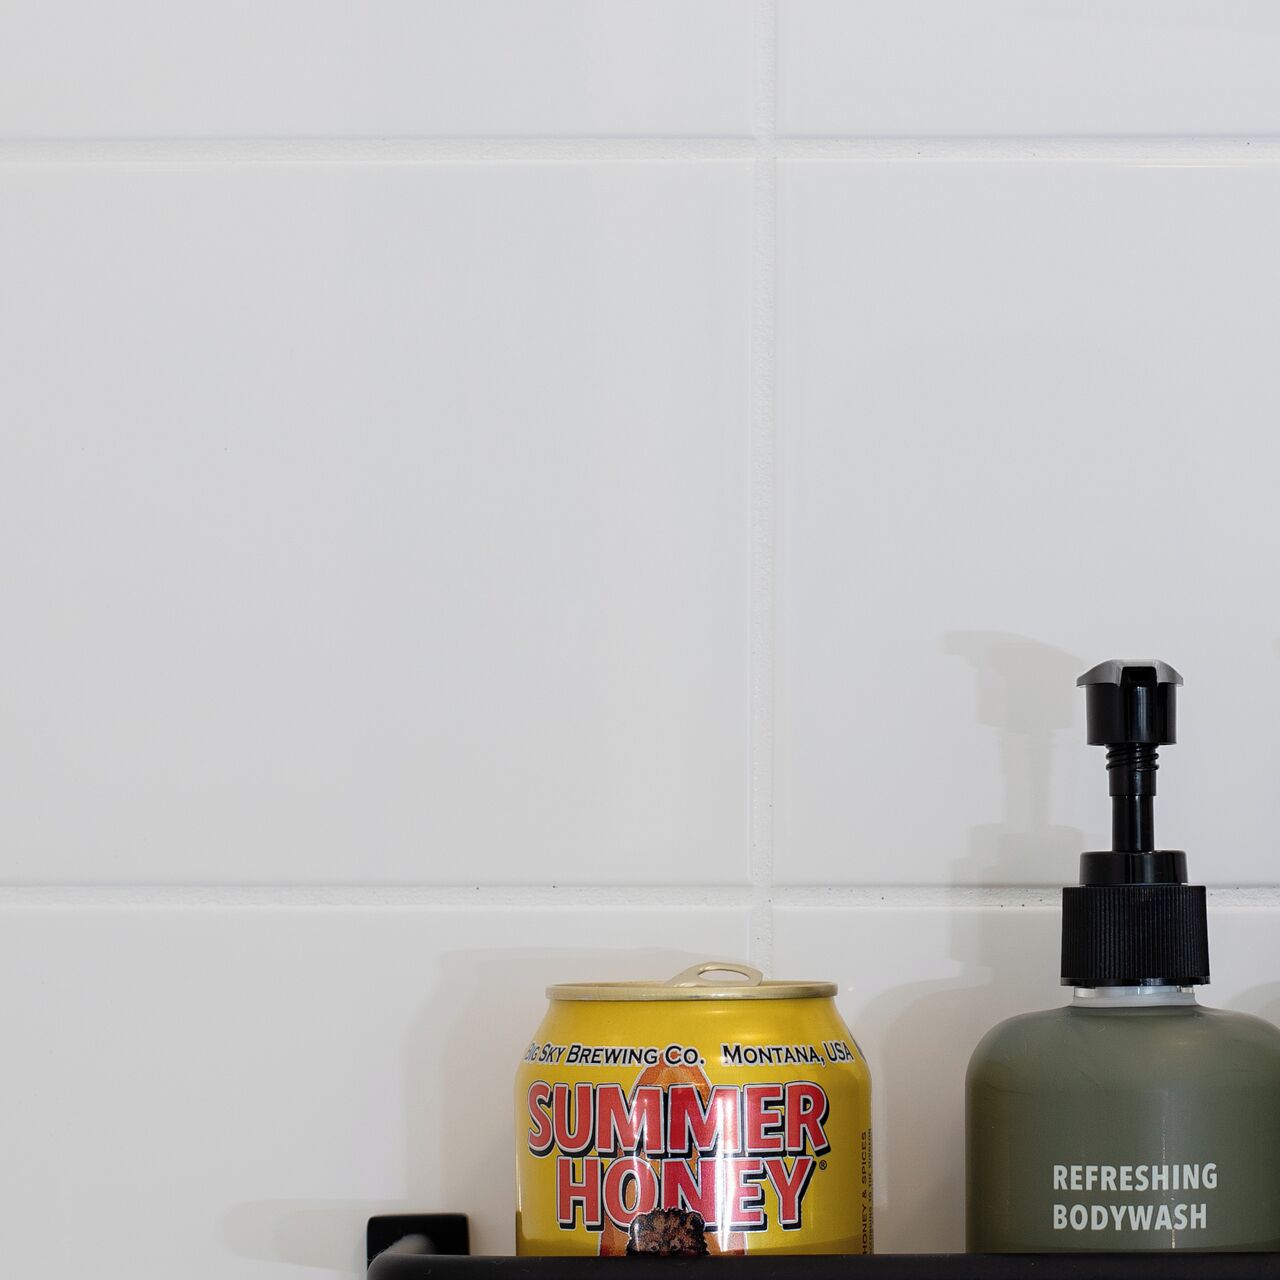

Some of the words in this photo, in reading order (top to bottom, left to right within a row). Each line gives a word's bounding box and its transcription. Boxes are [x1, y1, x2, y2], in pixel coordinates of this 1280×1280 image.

[538, 1042, 567, 1062] SKY
[566, 1044, 659, 1065] BREWING
[665, 1045, 705, 1066] CO.
[722, 1044, 825, 1066] MONTANA,
[823, 1041, 855, 1063] USA
[528, 1081, 830, 1158] SUMMER
[1053, 1162, 1218, 1191] REFRESHING
[556, 1155, 816, 1233] HONEY
[1053, 1202, 1207, 1231] BODYWASH
